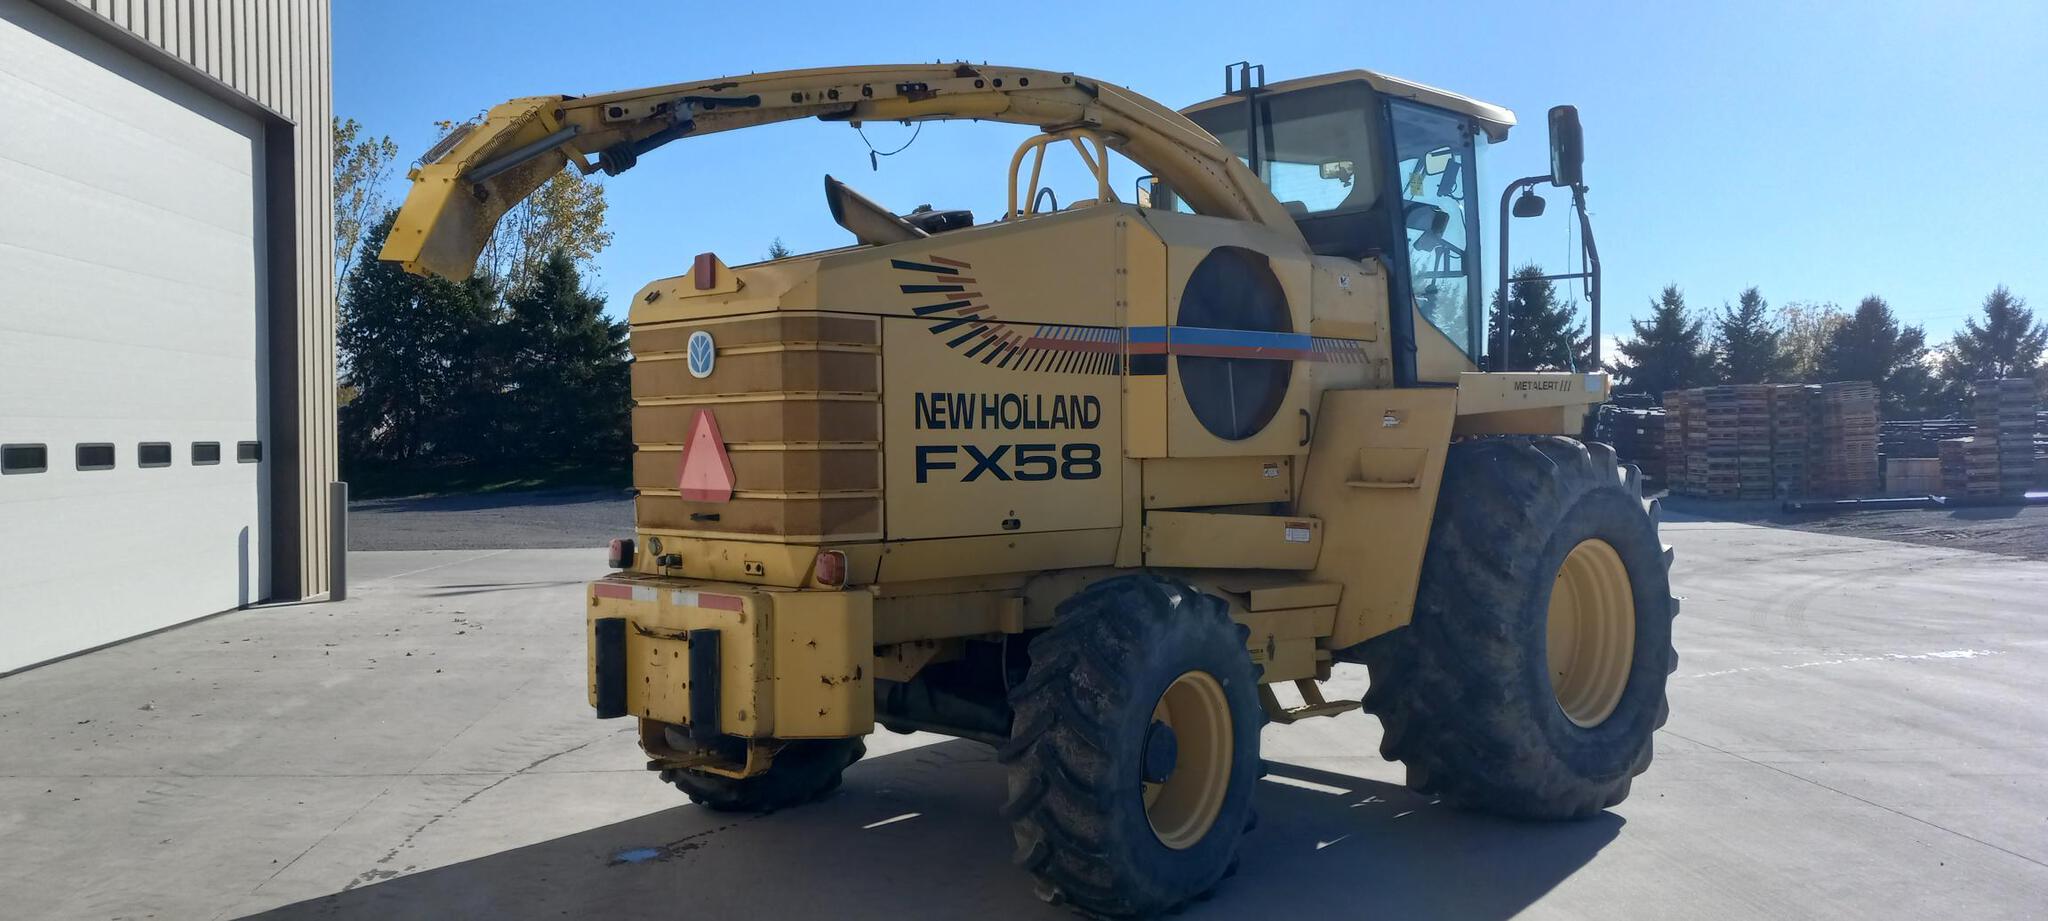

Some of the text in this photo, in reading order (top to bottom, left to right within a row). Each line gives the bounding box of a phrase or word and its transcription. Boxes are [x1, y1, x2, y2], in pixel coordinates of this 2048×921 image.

[1514, 381, 1559, 391] METALERT
[914, 392, 1101, 430] NEW HOLLAND
[915, 443, 1102, 484] FX58
